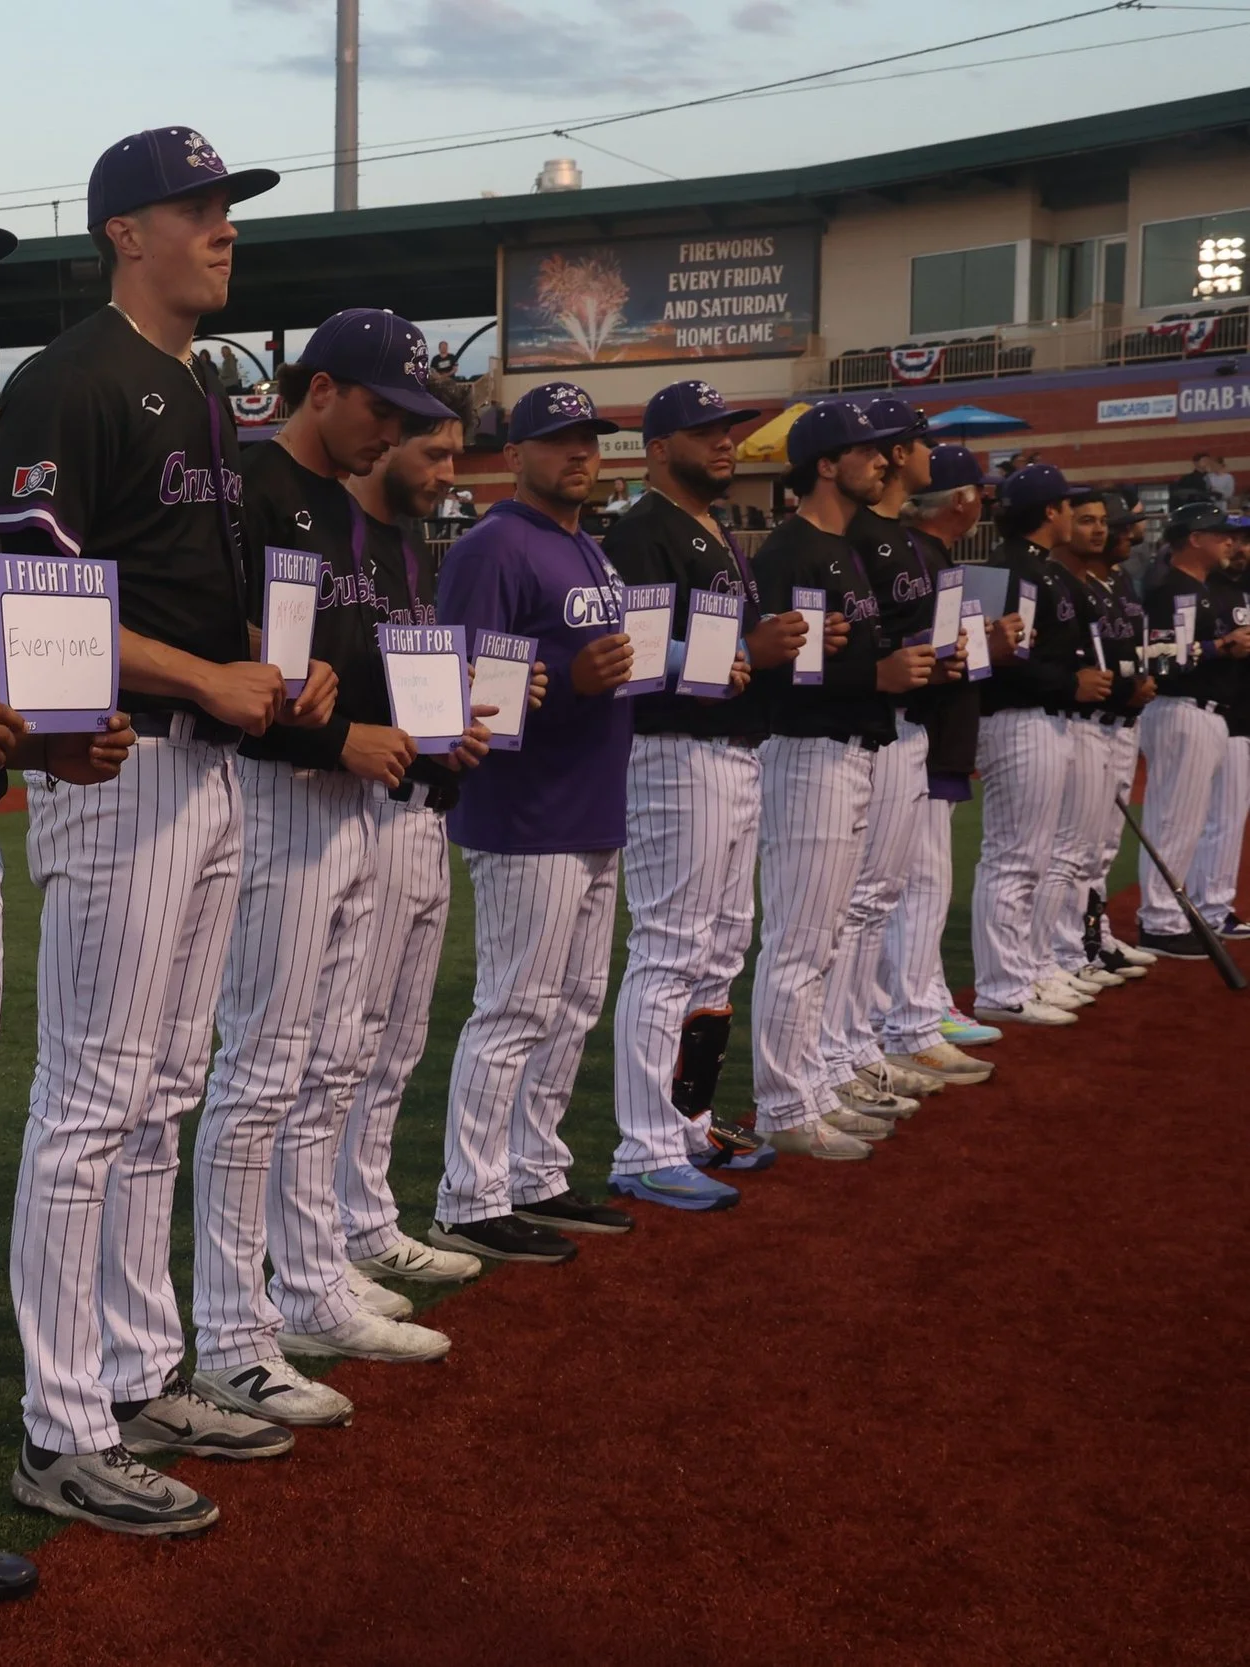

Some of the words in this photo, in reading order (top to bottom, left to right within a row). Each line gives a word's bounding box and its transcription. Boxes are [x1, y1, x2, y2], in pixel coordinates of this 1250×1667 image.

[679, 236, 775, 263] FIREWORKS
[668, 269, 721, 292] EVERY
[723, 264, 784, 288] FRIDAY
[663, 300, 698, 320] AND
[700, 292, 788, 318] SATURDAY
[676, 326, 723, 347] HOME
[725, 322, 774, 344] GAME
[614, 440, 642, 451] GRIL
[5, 560, 14, 590] I
[17, 561, 69, 593] FIGHT
[74, 564, 106, 594] FOR
[563, 587, 621, 628] Crus
[628, 589, 631, 609] I
[632, 589, 655, 608] FIGHT
[656, 587, 670, 607] FOR
[695, 592, 700, 611] I
[700, 593, 723, 615] FIGHT
[724, 597, 738, 617] FOR
[8, 627, 106, 666] Everyone
[385, 628, 391, 650] I
[392, 628, 422, 652] FIGHT
[427, 629, 453, 652] FOR
[480, 634, 487, 655] I
[487, 635, 511, 658] FIGHT
[512, 639, 530, 660] FOR
